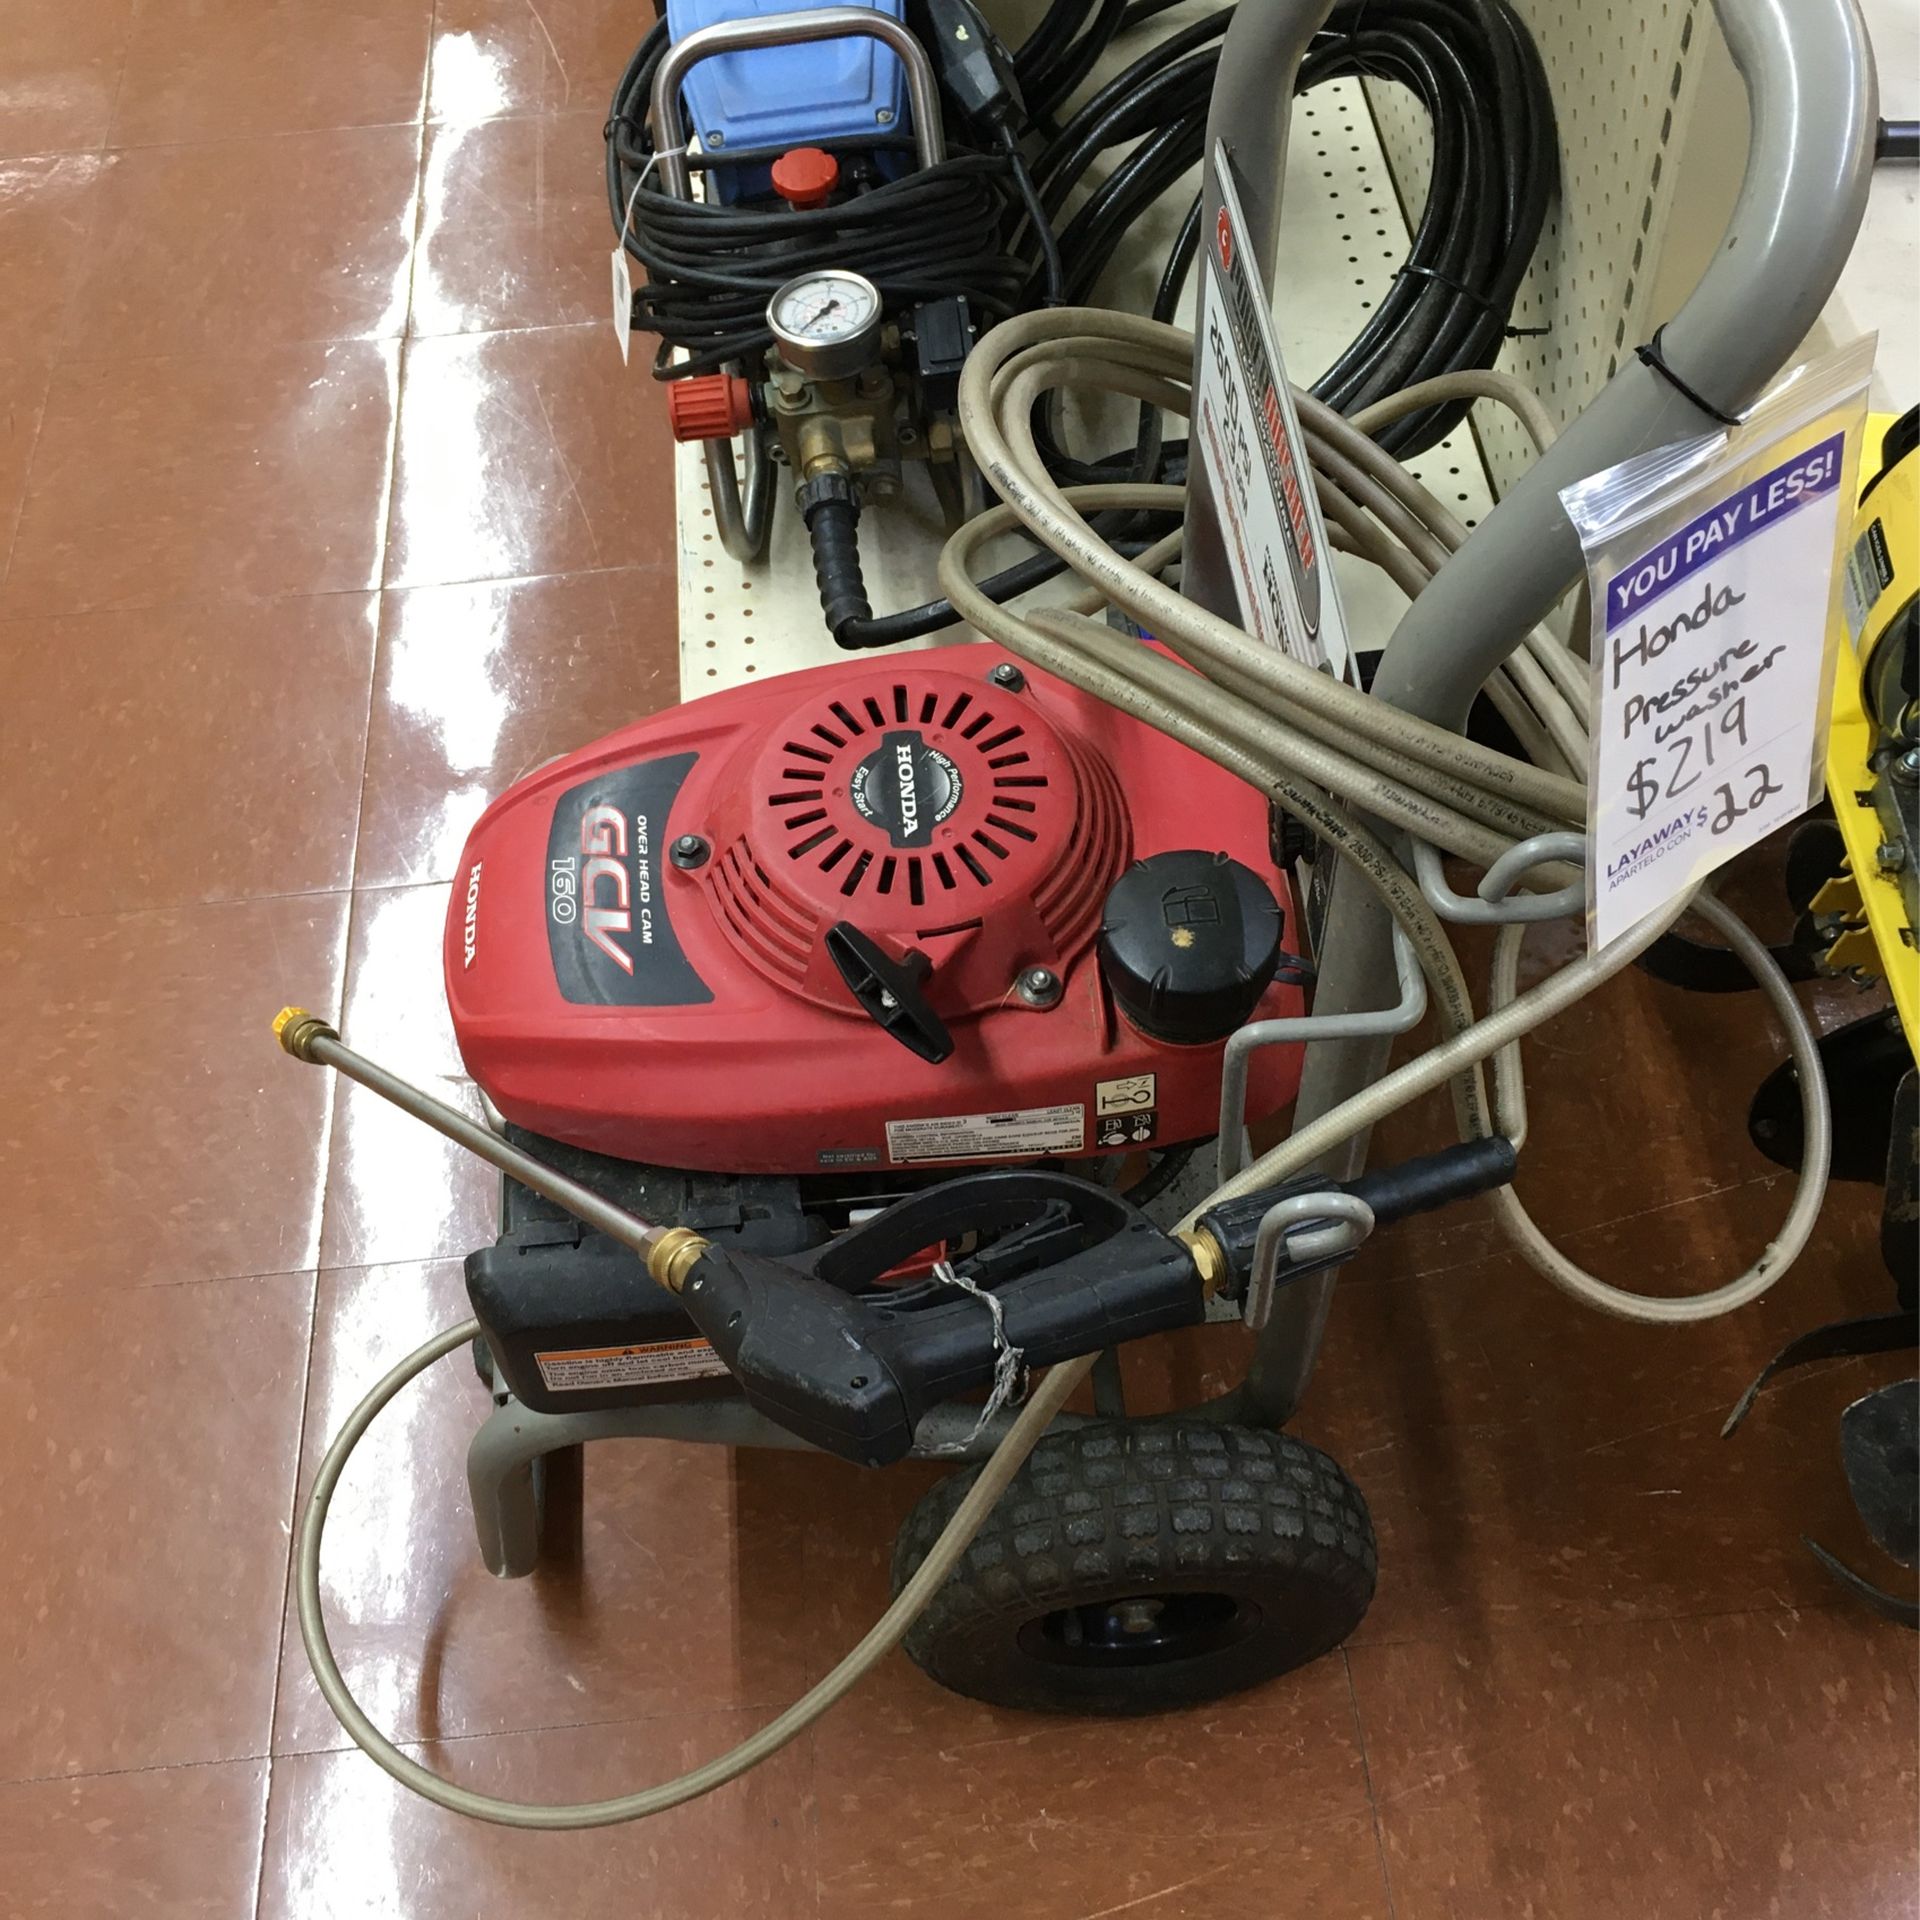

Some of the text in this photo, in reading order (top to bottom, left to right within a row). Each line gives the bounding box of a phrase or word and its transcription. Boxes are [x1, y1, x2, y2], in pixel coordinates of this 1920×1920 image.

[1616, 450, 1834, 610] YOU PAY LESS!
[1613, 582, 1747, 690] Honda
[1623, 639, 1759, 740] Pressure
[1655, 645, 1787, 744] washer
[851, 766, 874, 817] Easy Start
[896, 744, 918, 838] HONDA
[928, 750, 962, 822] High Performance
[1626, 695, 1748, 821] $219
[637, 814, 653, 944] OVER HEAD CAM
[1606, 808, 1695, 879] LAYAWAY
[1666, 828, 1692, 852] CON
[464, 861, 483, 969] HONDA
[552, 857, 577, 924] 160
[581, 804, 635, 977] GCV
[640, 1343, 692, 1354] WARNING
